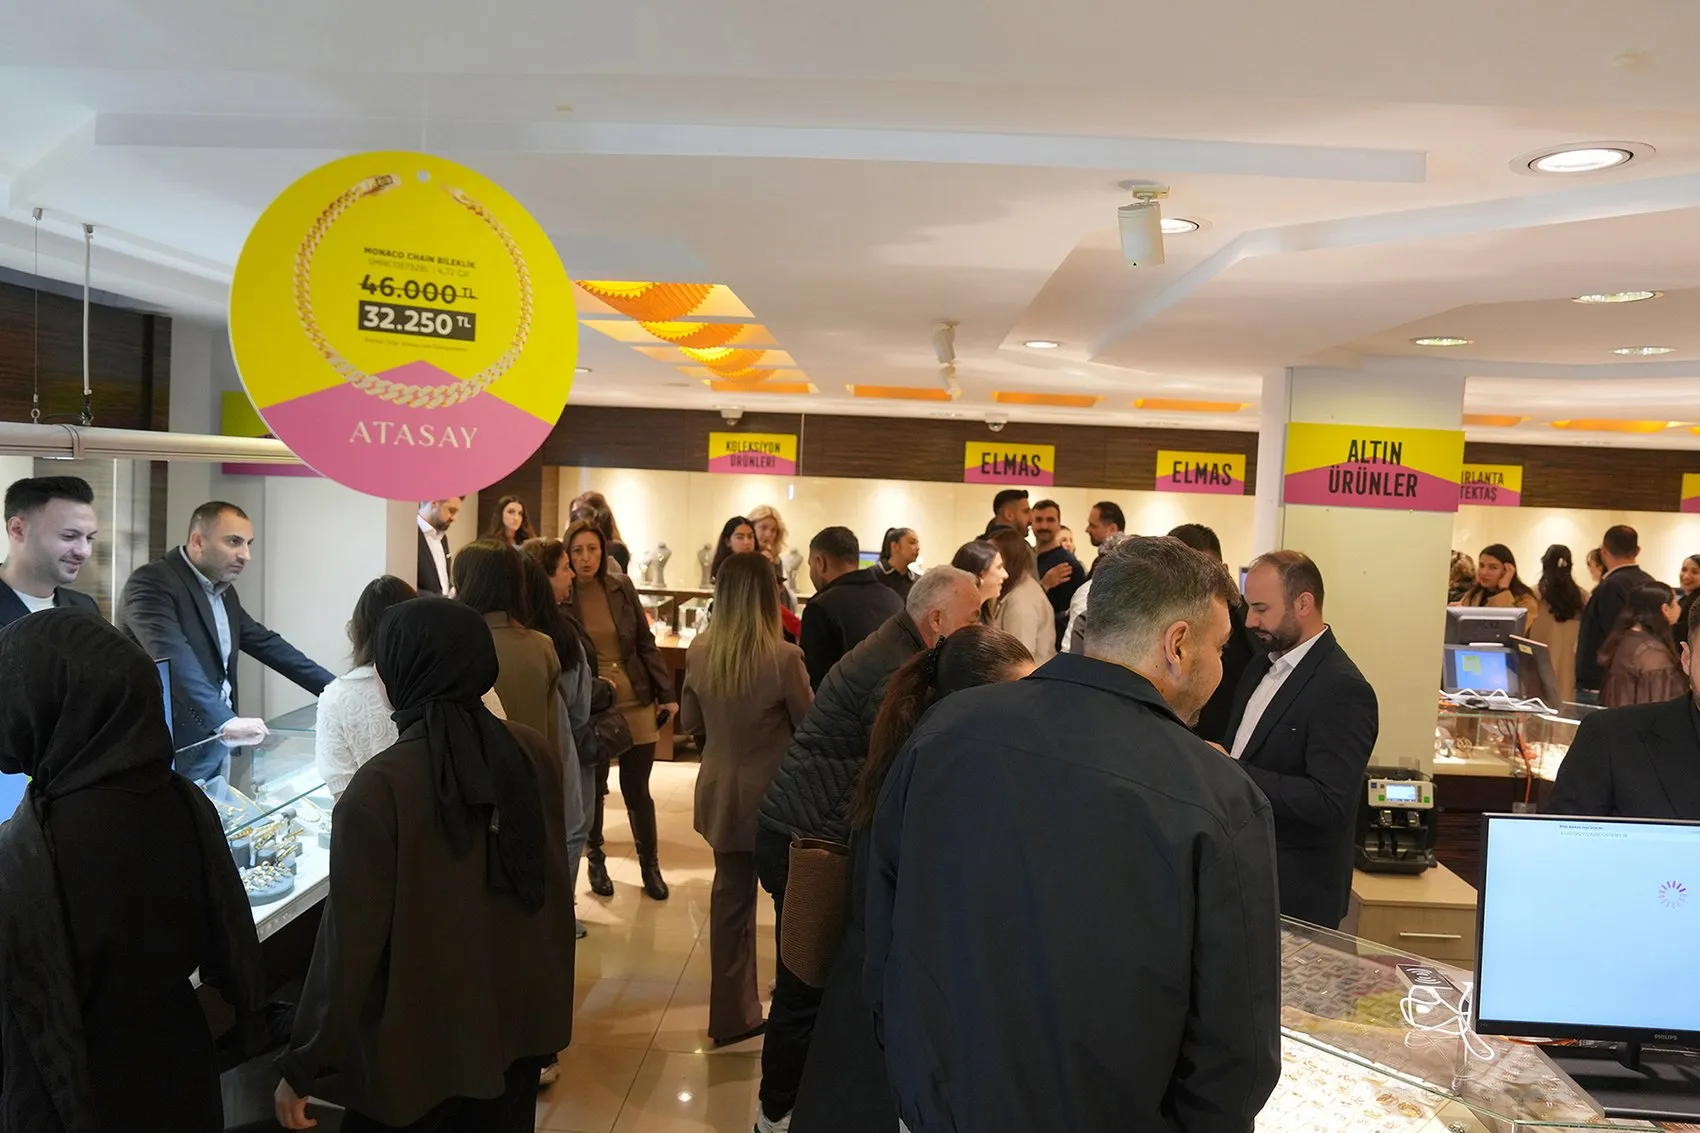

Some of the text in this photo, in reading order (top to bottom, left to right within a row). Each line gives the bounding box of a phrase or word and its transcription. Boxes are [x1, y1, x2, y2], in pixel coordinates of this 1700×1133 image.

[407, 253, 434, 262] CHAIN
[361, 274, 475, 304] 46.000 TL
[363, 305, 471, 335] 32.250 TL
[349, 420, 478, 449] ATASAY
[726, 440, 781, 453] KOLEKSİYON
[981, 452, 1041, 477] ELMAS
[1347, 439, 1403, 465] ALTIN
[1172, 461, 1232, 486] ELMAS
[1328, 465, 1418, 498] ÜRÜNLER
[1461, 471, 1504, 485] IRLANTA
